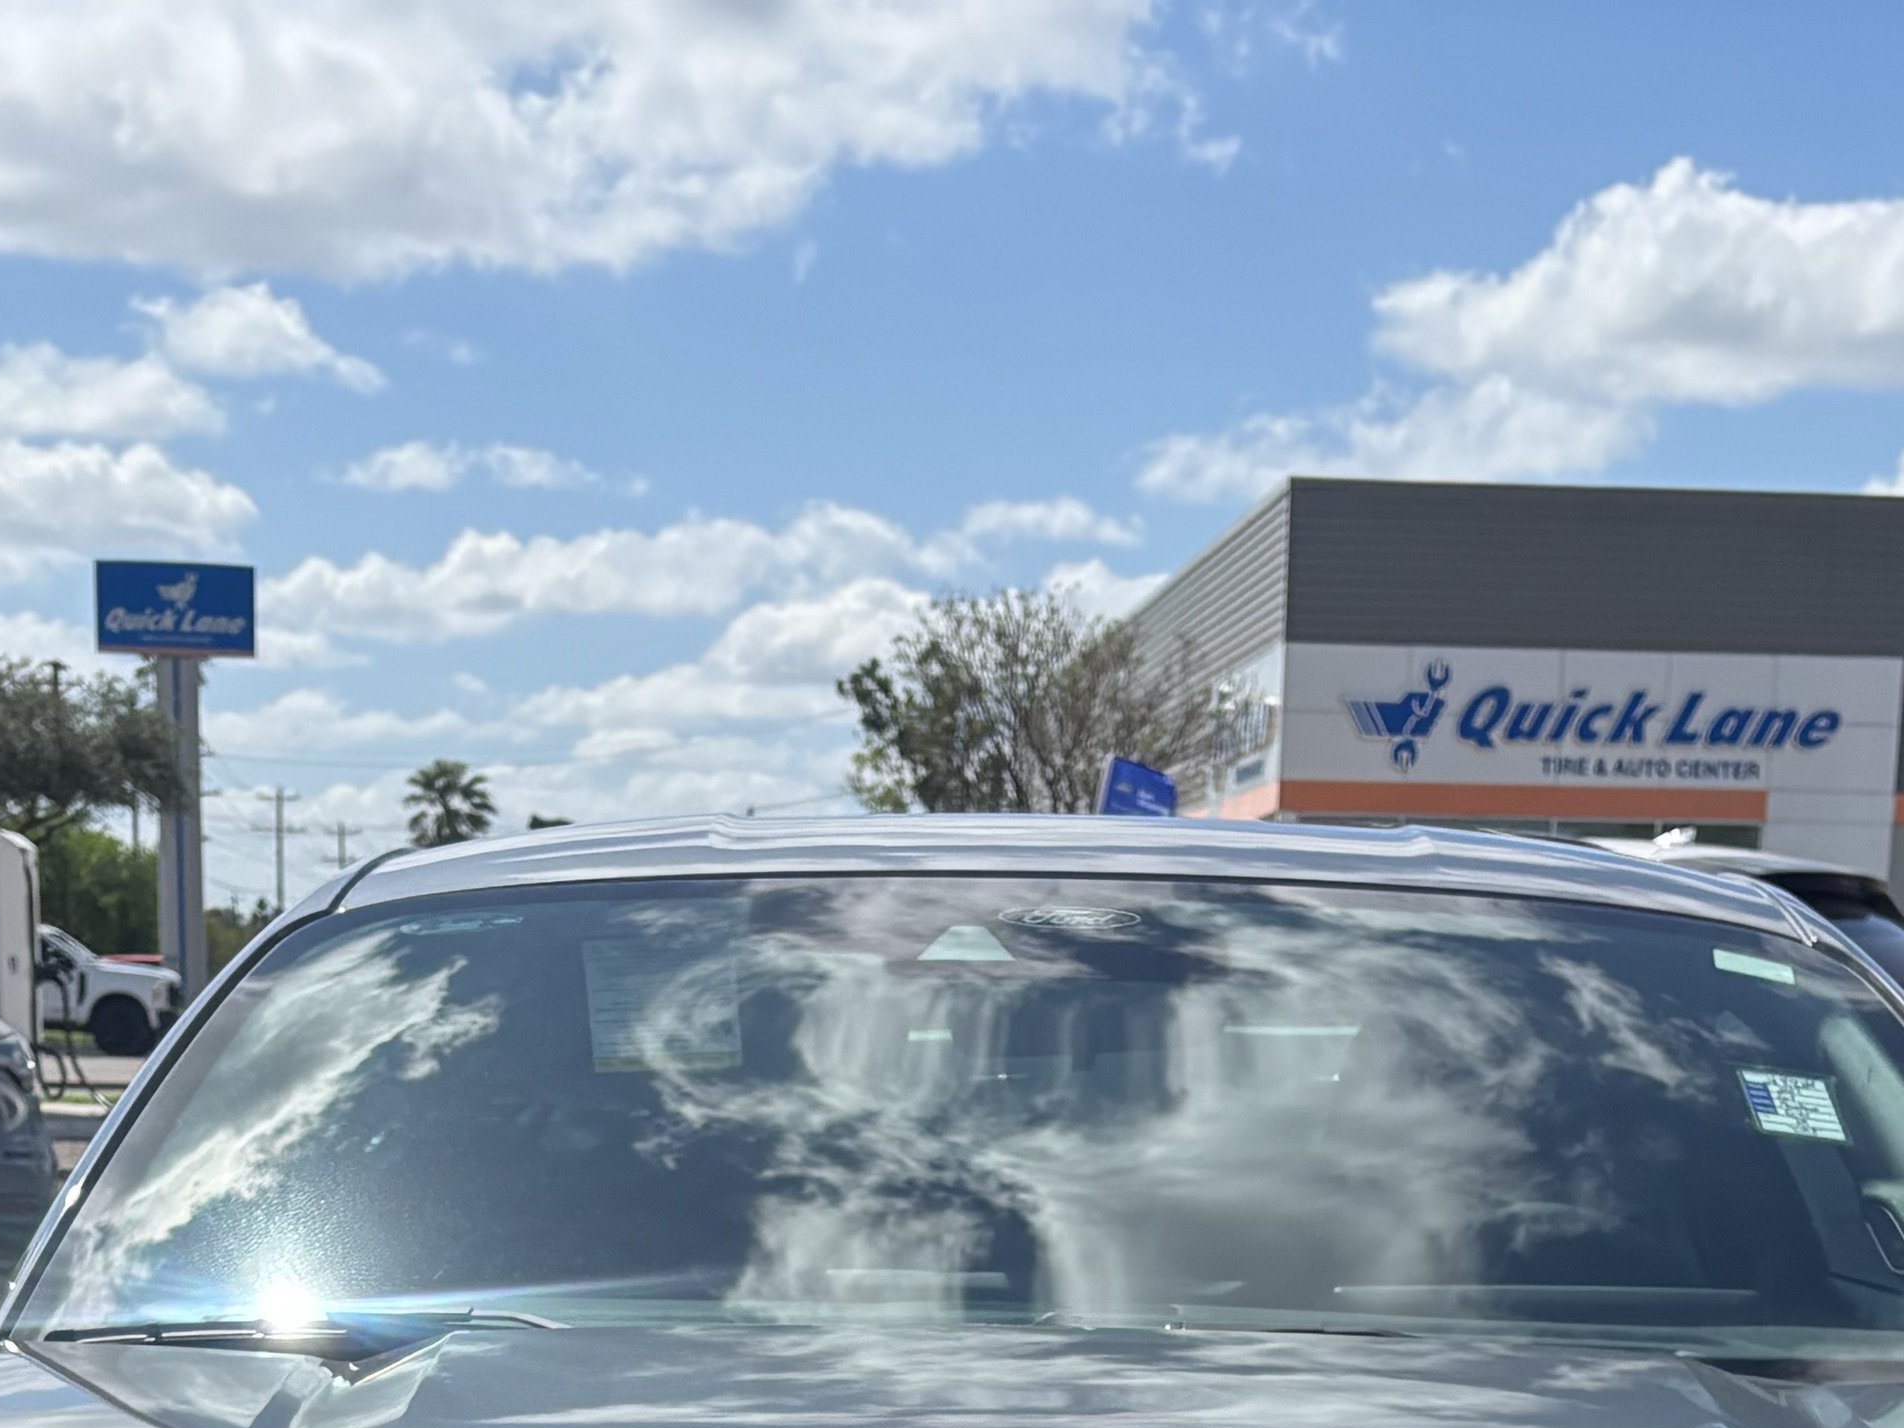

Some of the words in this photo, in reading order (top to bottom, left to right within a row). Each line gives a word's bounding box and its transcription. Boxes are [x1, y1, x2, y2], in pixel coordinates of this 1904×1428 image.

[104, 607, 177, 633] Quick
[1457, 686, 1662, 748] Quick
[1663, 690, 1843, 750] Lane
[1541, 757, 1588, 776] TIRE
[1593, 757, 1607, 777] &
[1612, 758, 1672, 778] AUTO
[1674, 758, 1761, 780] CENTER
